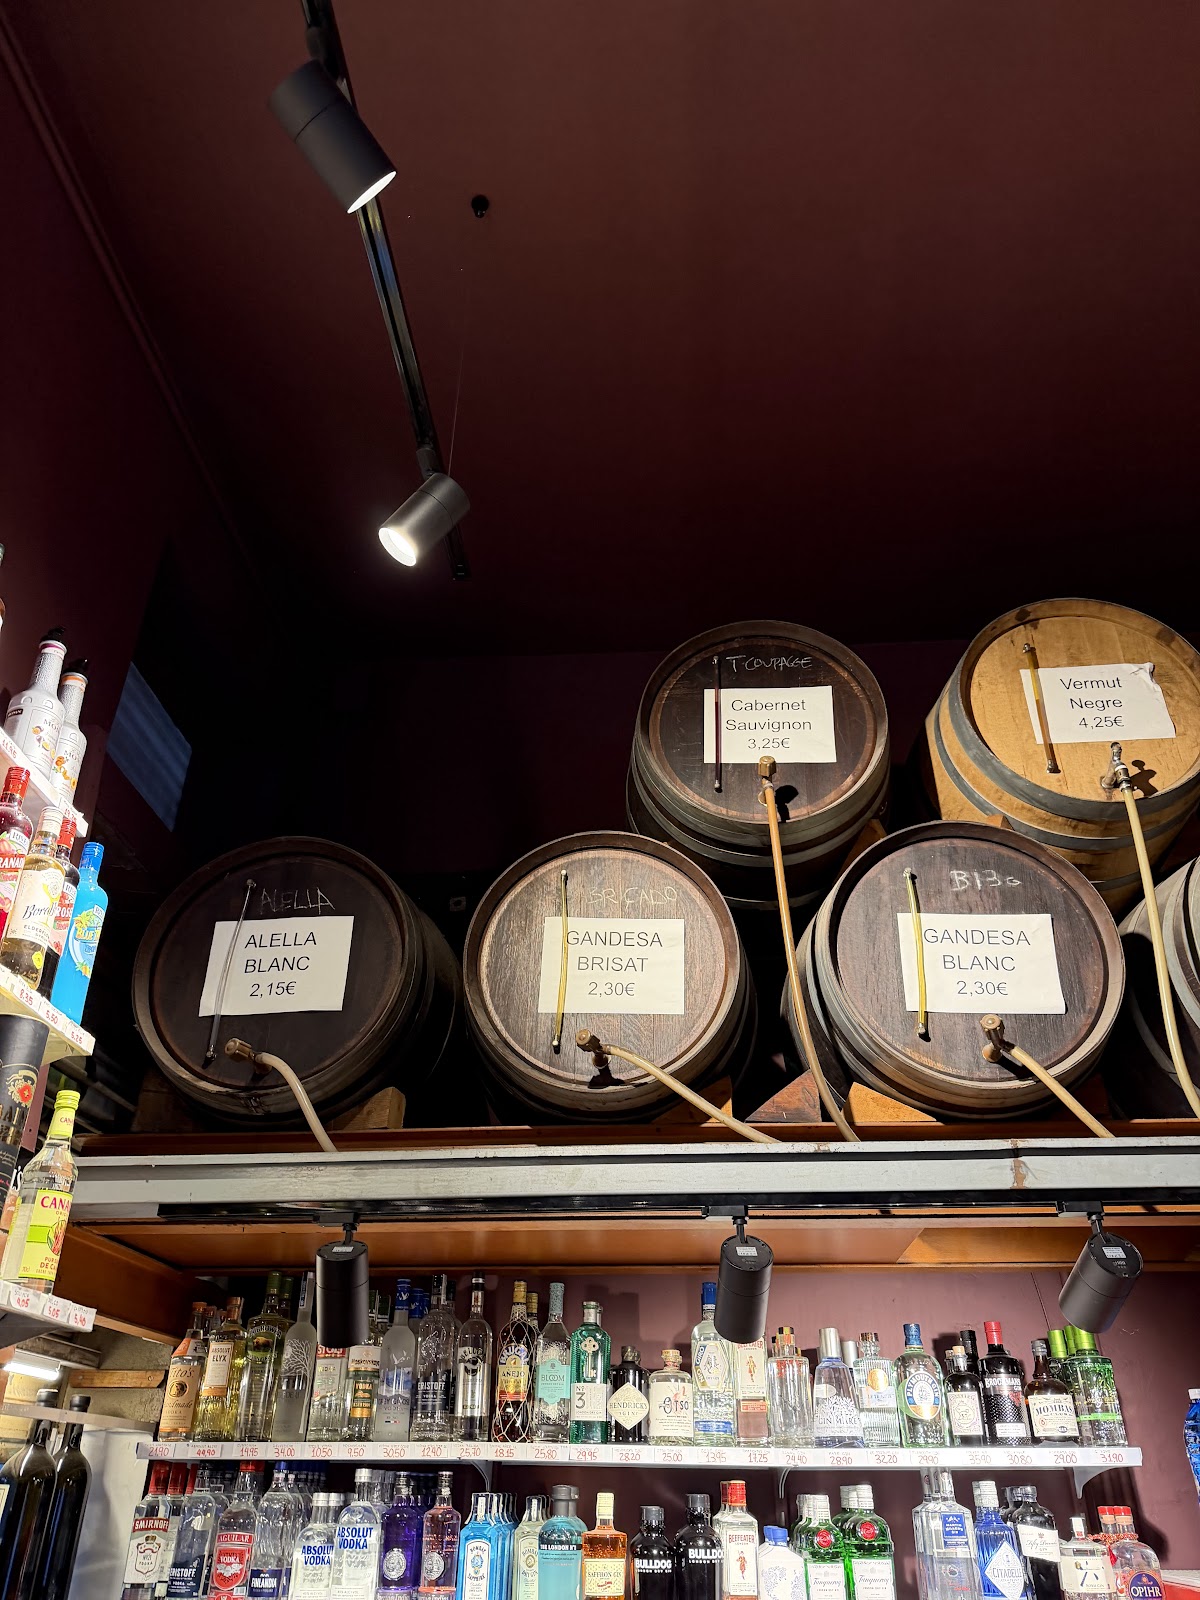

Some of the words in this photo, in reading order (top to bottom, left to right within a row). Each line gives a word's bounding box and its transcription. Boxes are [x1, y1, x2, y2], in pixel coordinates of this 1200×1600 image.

[1060, 677, 1122, 690] Vermut
[731, 699, 807, 711] Cabernet
[1069, 698, 1123, 712] Negre
[725, 718, 812, 733] Sauvignon
[1078, 715, 1125, 730] 4,25€
[748, 737, 790, 750] 3,25€
[245, 931, 317, 949] ALELLA
[567, 930, 663, 947] GANDESA
[923, 928, 1031, 946] GANDESA
[244, 956, 310, 974] BLANC
[577, 956, 649, 972] BRISAT
[943, 954, 1016, 971] BLANC
[250, 981, 297, 998] 2,15€
[588, 981, 636, 998] 2,30€
[956, 980, 1009, 997] 2,30€
[212, 1354, 227, 1362] ELYX
[337, 1527, 373, 1538] ABSOLUT
[728, 1534, 755, 1543] BEEFEATER
[301, 1545, 334, 1556] ABSOLUT
[339, 1539, 368, 1550] VODKA
[304, 1556, 331, 1565] VODKA
[635, 1559, 672, 1569] BULLDOG
